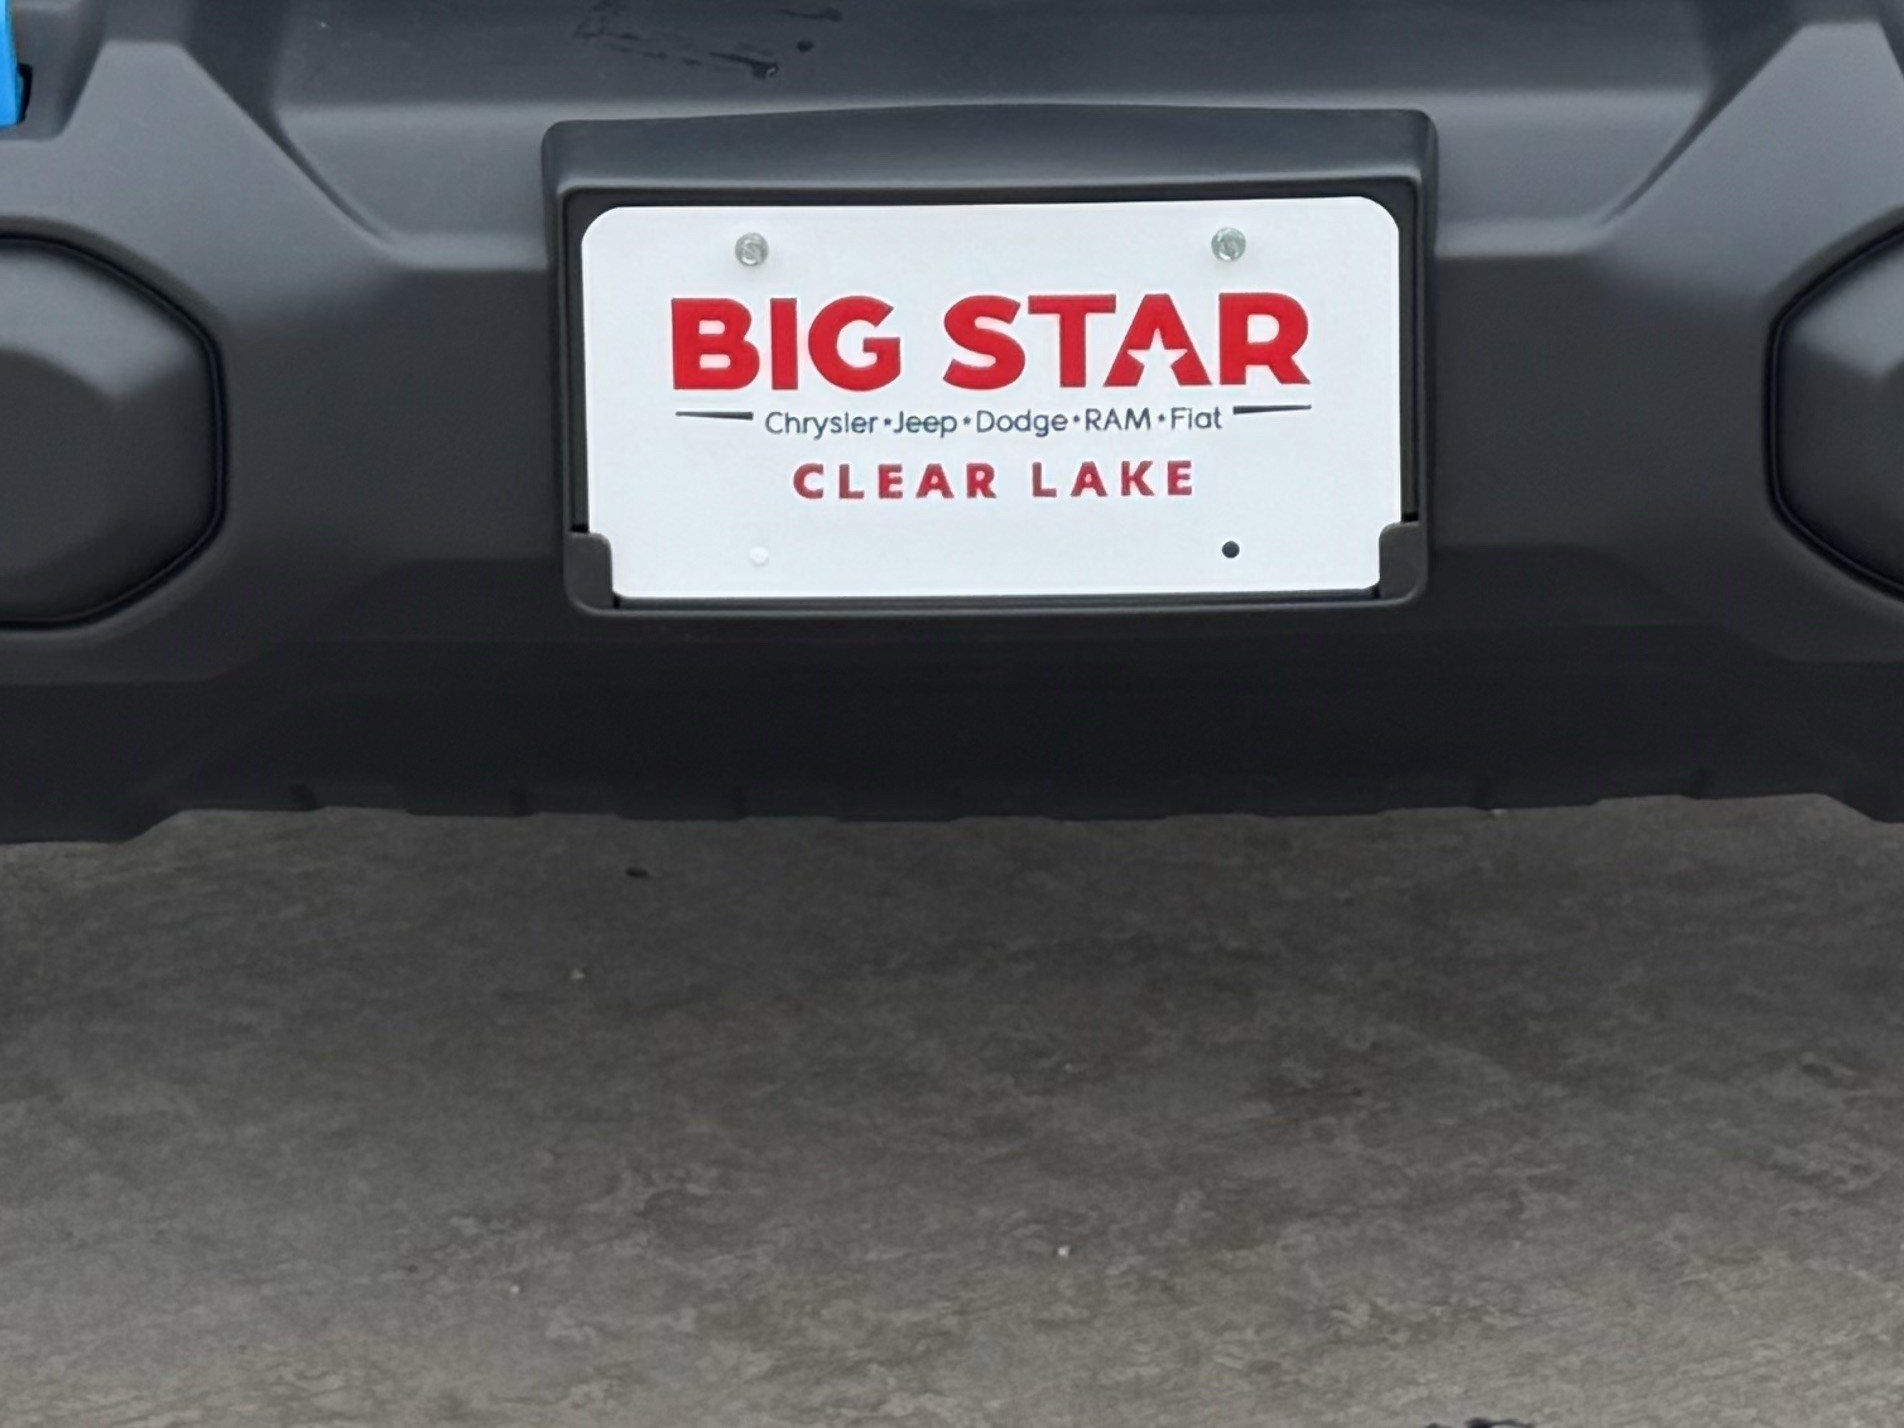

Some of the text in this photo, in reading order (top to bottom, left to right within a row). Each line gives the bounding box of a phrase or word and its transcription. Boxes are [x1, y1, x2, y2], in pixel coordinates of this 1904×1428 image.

[670, 292, 1310, 392] BIG STAR
[764, 406, 1223, 440] Chrysler Jeep Dodge RAM Fiat
[793, 459, 1193, 500] CLEAR LAKE
